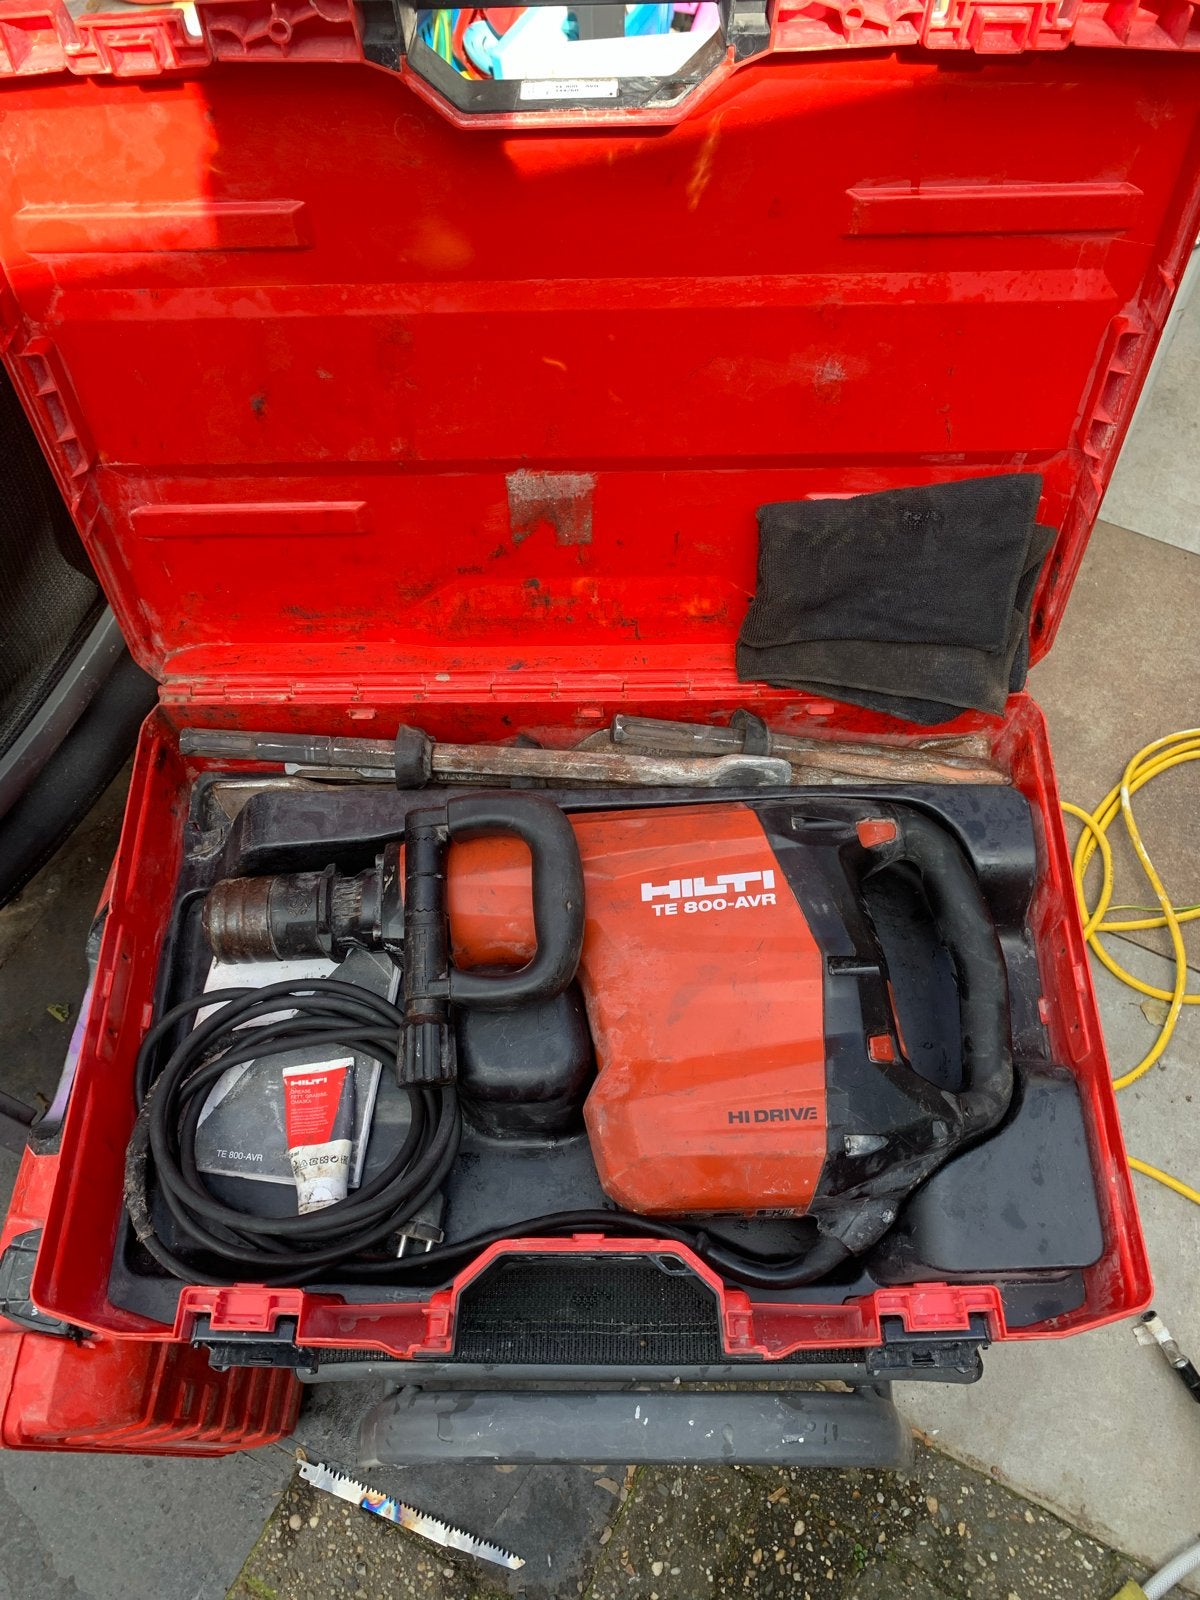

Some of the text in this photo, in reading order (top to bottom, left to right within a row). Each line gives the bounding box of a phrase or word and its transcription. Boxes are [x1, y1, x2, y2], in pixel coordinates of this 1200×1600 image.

[641, 869, 775, 902] HILTI
[651, 893, 777, 917] TE 800-AVR
[290, 1077, 328, 1086] HILTI
[728, 1106, 818, 1124] HI DRIVE
[217, 1149, 263, 1162] TE 800-AVR
